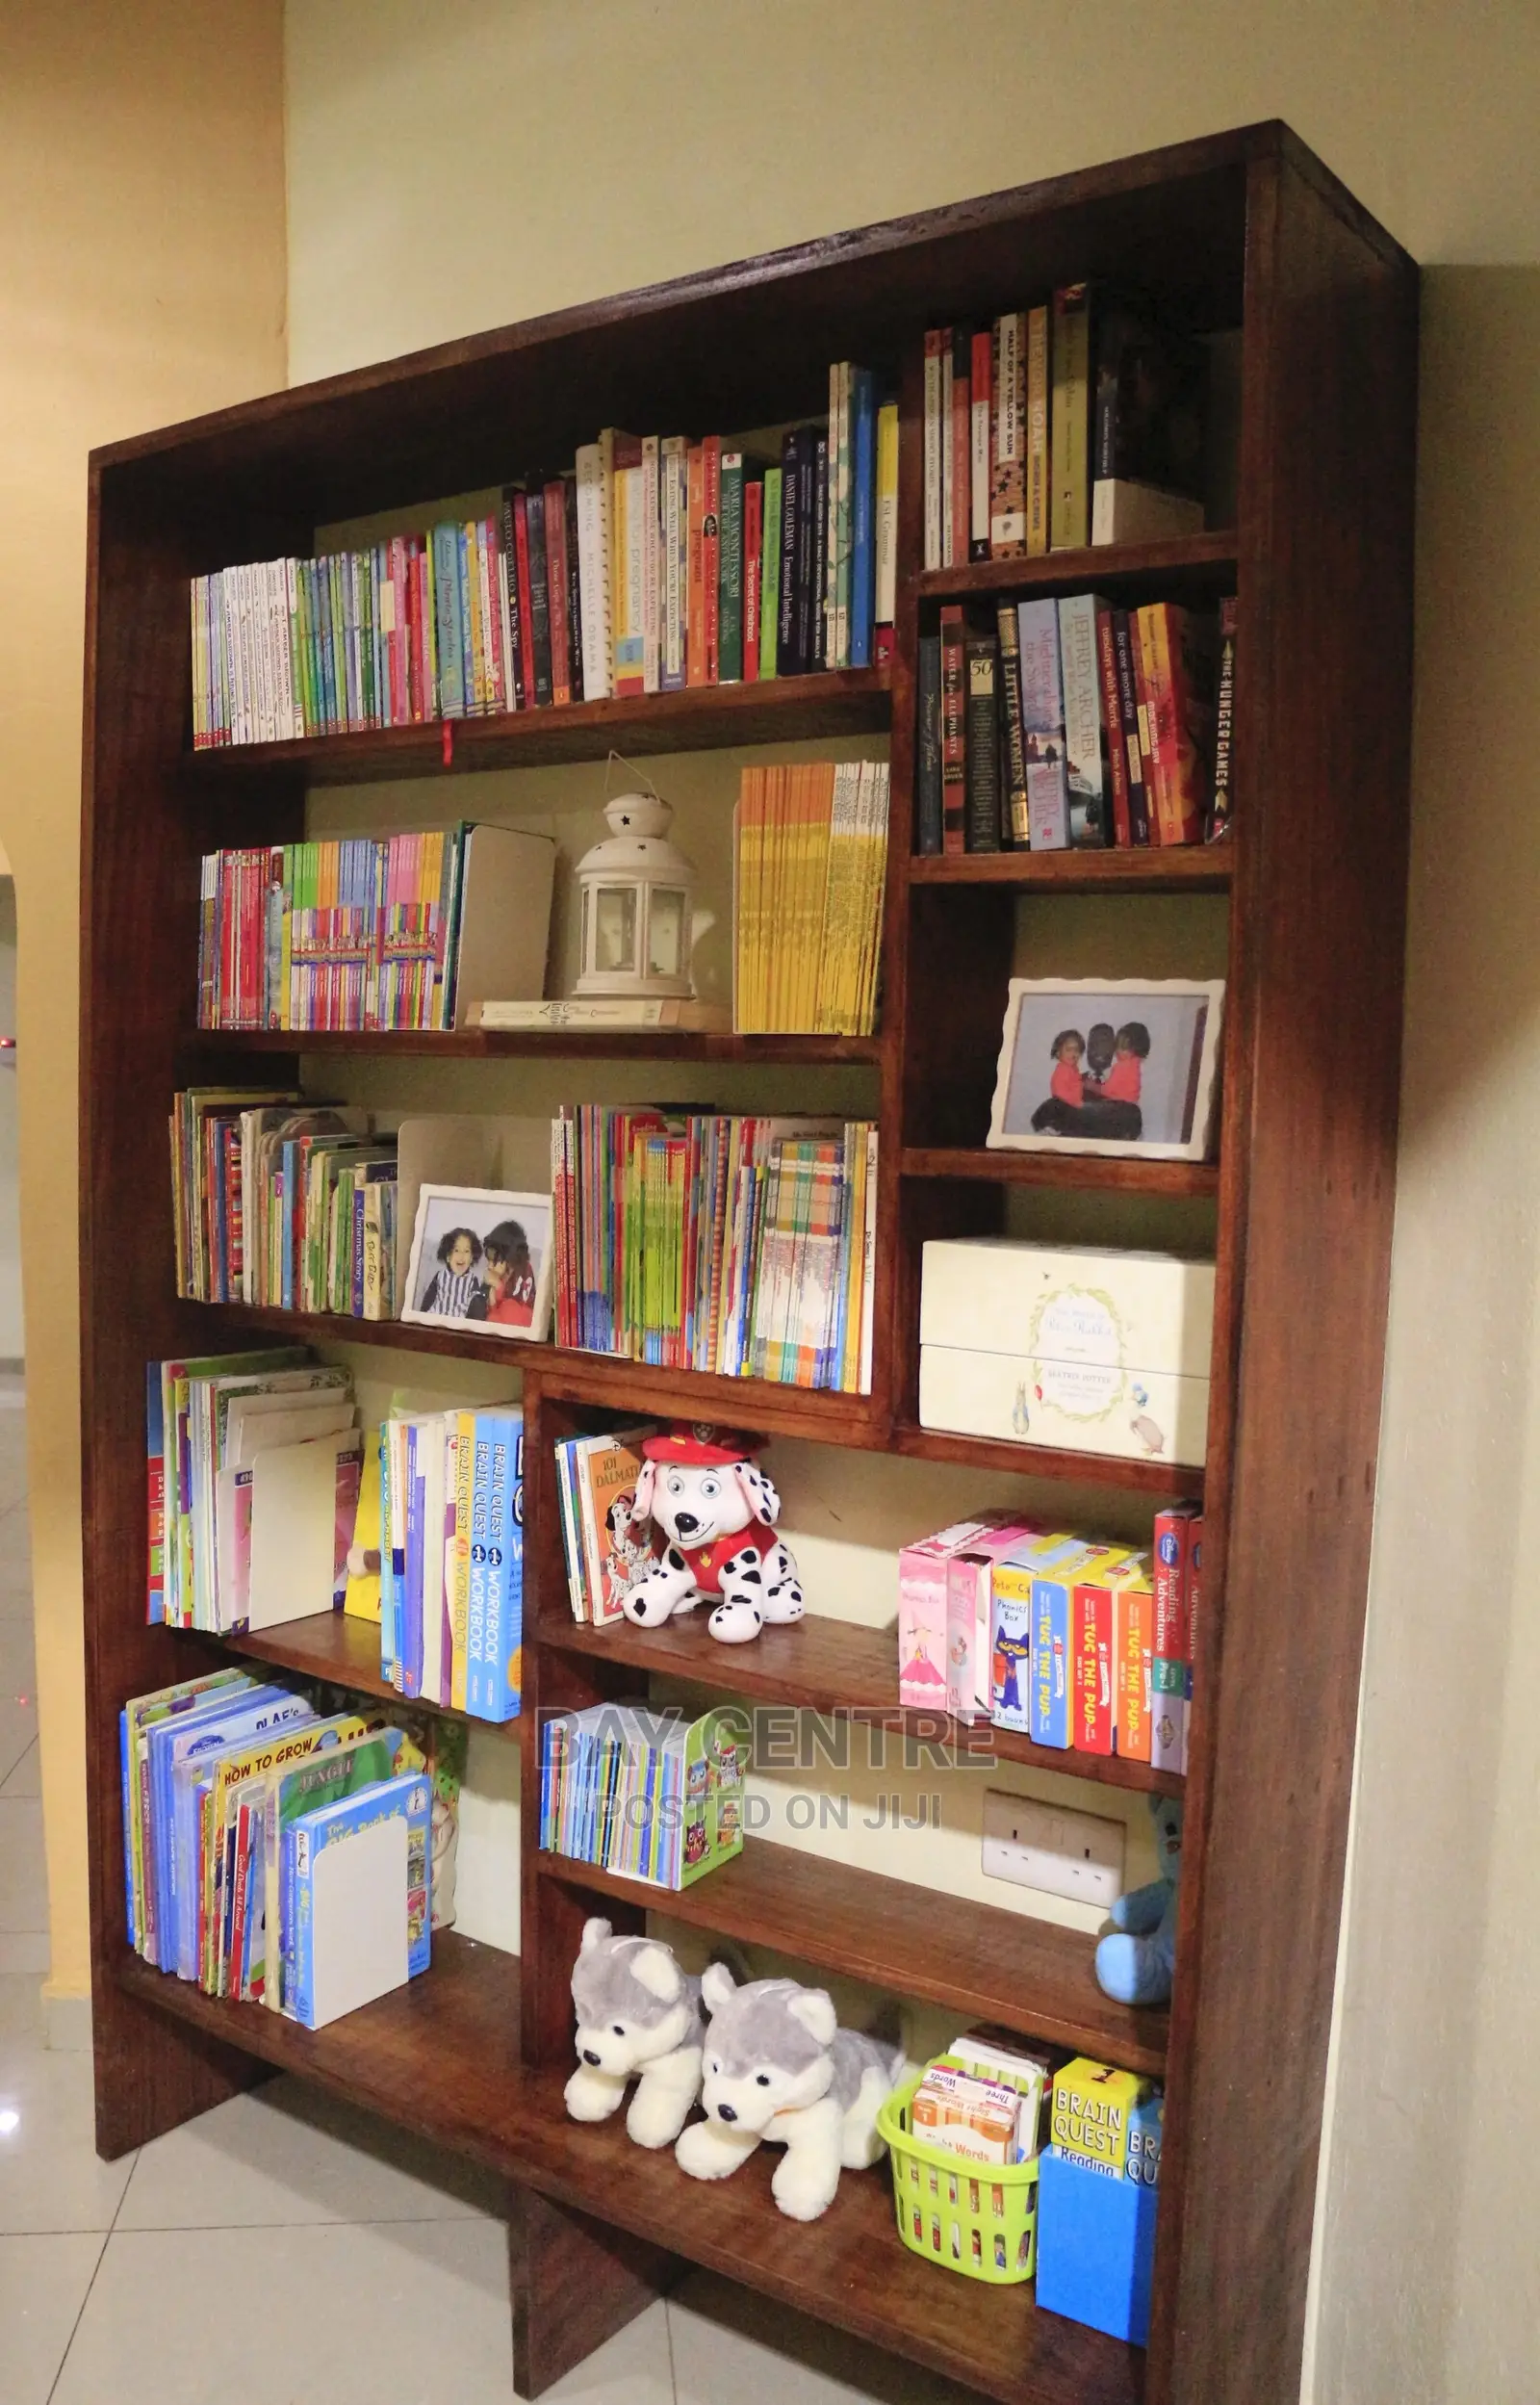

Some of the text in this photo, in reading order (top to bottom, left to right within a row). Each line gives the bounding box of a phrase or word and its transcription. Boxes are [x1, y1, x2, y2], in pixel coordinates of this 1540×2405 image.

[1006, 329, 1015, 357] HALF
[1006, 359, 1015, 374] OF
[1006, 388, 1014, 429] YELLOW
[1031, 400, 1045, 454] NOAH
[1006, 433, 1014, 455] SUN
[669, 478, 678, 642] EATING WELL WHEN YOU'RE EXPECTING
[692, 529, 705, 583] pregnant
[728, 477, 740, 598] MARIA MONTESSORI
[781, 474, 797, 644] DANIEL GOLEMAN Emotional Intelligence
[880, 520, 891, 566] Grammar
[505, 542, 517, 593] COELHO
[552, 558, 560, 582] Three
[583, 462, 597, 674] BECOMING MICHELLE OBAMA
[628, 548, 644, 633] pregnancy
[509, 608, 520, 630] The
[746, 559, 756, 643] The Secret of Childhood
[510, 631, 521, 649] Spy
[1037, 628, 1053, 687] Mightier
[1071, 613, 1091, 679] JEFFREY
[970, 659, 993, 676] 50
[1025, 642, 1039, 712] the Sword
[1101, 627, 1118, 729] tuesdays with Morrie
[1116, 632, 1134, 719] for one more day
[946, 648, 958, 755] WATER for ELEPHANTS
[1004, 662, 1025, 786] LITTLE WOMEN
[1078, 685, 1096, 760] ARCHER
[1216, 660, 1233, 787] THE HUNGER GAMES
[353, 1208, 365, 1282] Christmas Story
[1048, 1370, 1112, 1384] BEATRIX POTTER
[475, 1441, 490, 1488] BRAIN
[490, 1443, 506, 1492] BRAIN
[603, 1457, 617, 1471] 101
[473, 1492, 488, 1540] QUEST
[488, 1494, 504, 1543] QUEST
[453, 1435, 473, 1654] BRAIN QUEST WORKBOOK
[468, 1566, 486, 1662] WORKBOOK
[484, 1569, 501, 1665] WORKBOOK
[997, 1598, 1029, 1616] Phonics
[1004, 1612, 1019, 1622] Box
[1156, 1578, 1168, 1652] Adventures
[1167, 1568, 1181, 1623] Reading
[1039, 1649, 1052, 1679] THE
[1084, 1658, 1097, 1688] THE
[1127, 1664, 1141, 1694] THE
[1039, 1684, 1052, 1717] PUP
[1083, 1692, 1097, 1724] PUP
[1127, 1698, 1140, 1731] PUP
[224, 1736, 314, 1788] HOW TO GROW
[234, 1854, 246, 1931] Good Deeds All Around
[929, 2072, 1010, 2106] Three Words
[1091, 2068, 1116, 2083] 1
[921, 2112, 929, 2123] 1
[1055, 2086, 1121, 2131] BRAIN
[956, 2141, 990, 2163] Words
[1054, 2114, 1121, 2157] QUEST
[1060, 2146, 1115, 2178] Reading
